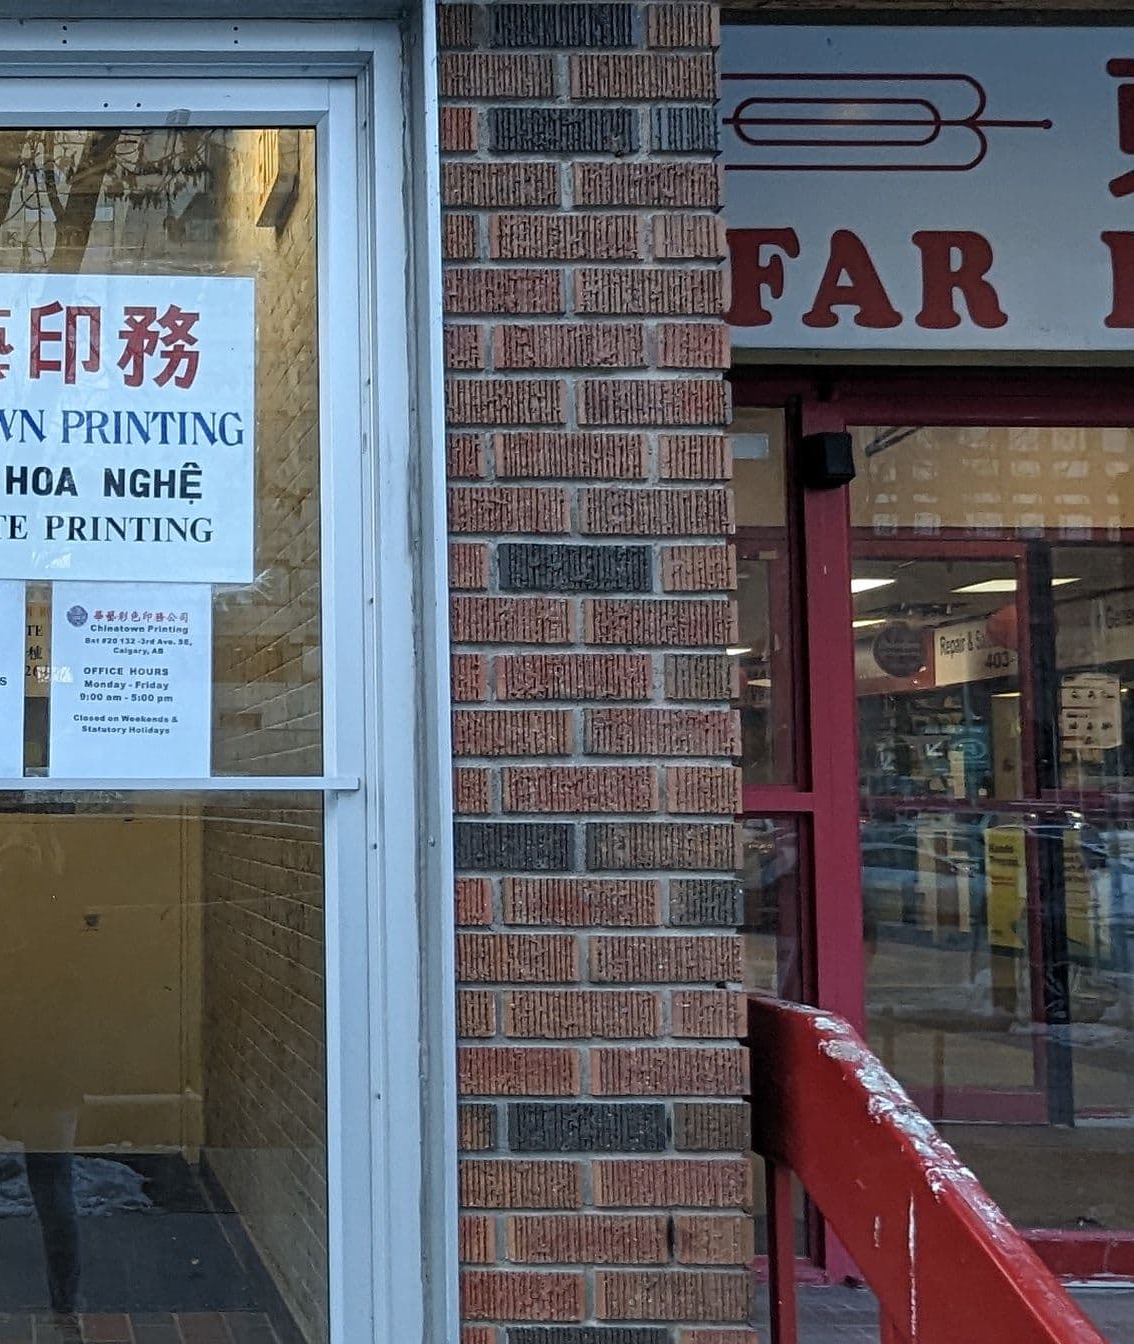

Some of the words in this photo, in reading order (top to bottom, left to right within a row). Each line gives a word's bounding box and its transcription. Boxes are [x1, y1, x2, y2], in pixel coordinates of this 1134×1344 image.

[724, 227, 1009, 329] FAR
[61, 410, 245, 447] PRINTING
[5, 465, 78, 497] HOA
[103, 462, 203, 505] NGHỆ
[45, 515, 213, 543] PRINTING
[90, 624, 145, 633] Chinatown
[147, 625, 189, 635] Printing
[113, 647, 150, 655] Calgary,
[83, 667, 124, 675] OFFICE
[129, 667, 169, 676] HOURS
[84, 680, 126, 690] Monday
[135, 681, 169, 691] Friday
[80, 692, 103, 701] 9:00
[130, 693, 154, 702] 5:00
[156, 695, 173, 703] pm
[73, 714, 106, 722] Closed
[121, 715, 169, 723] Weekends
[81, 725, 126, 734] Statutory
[129, 726, 170, 735] Holidays
